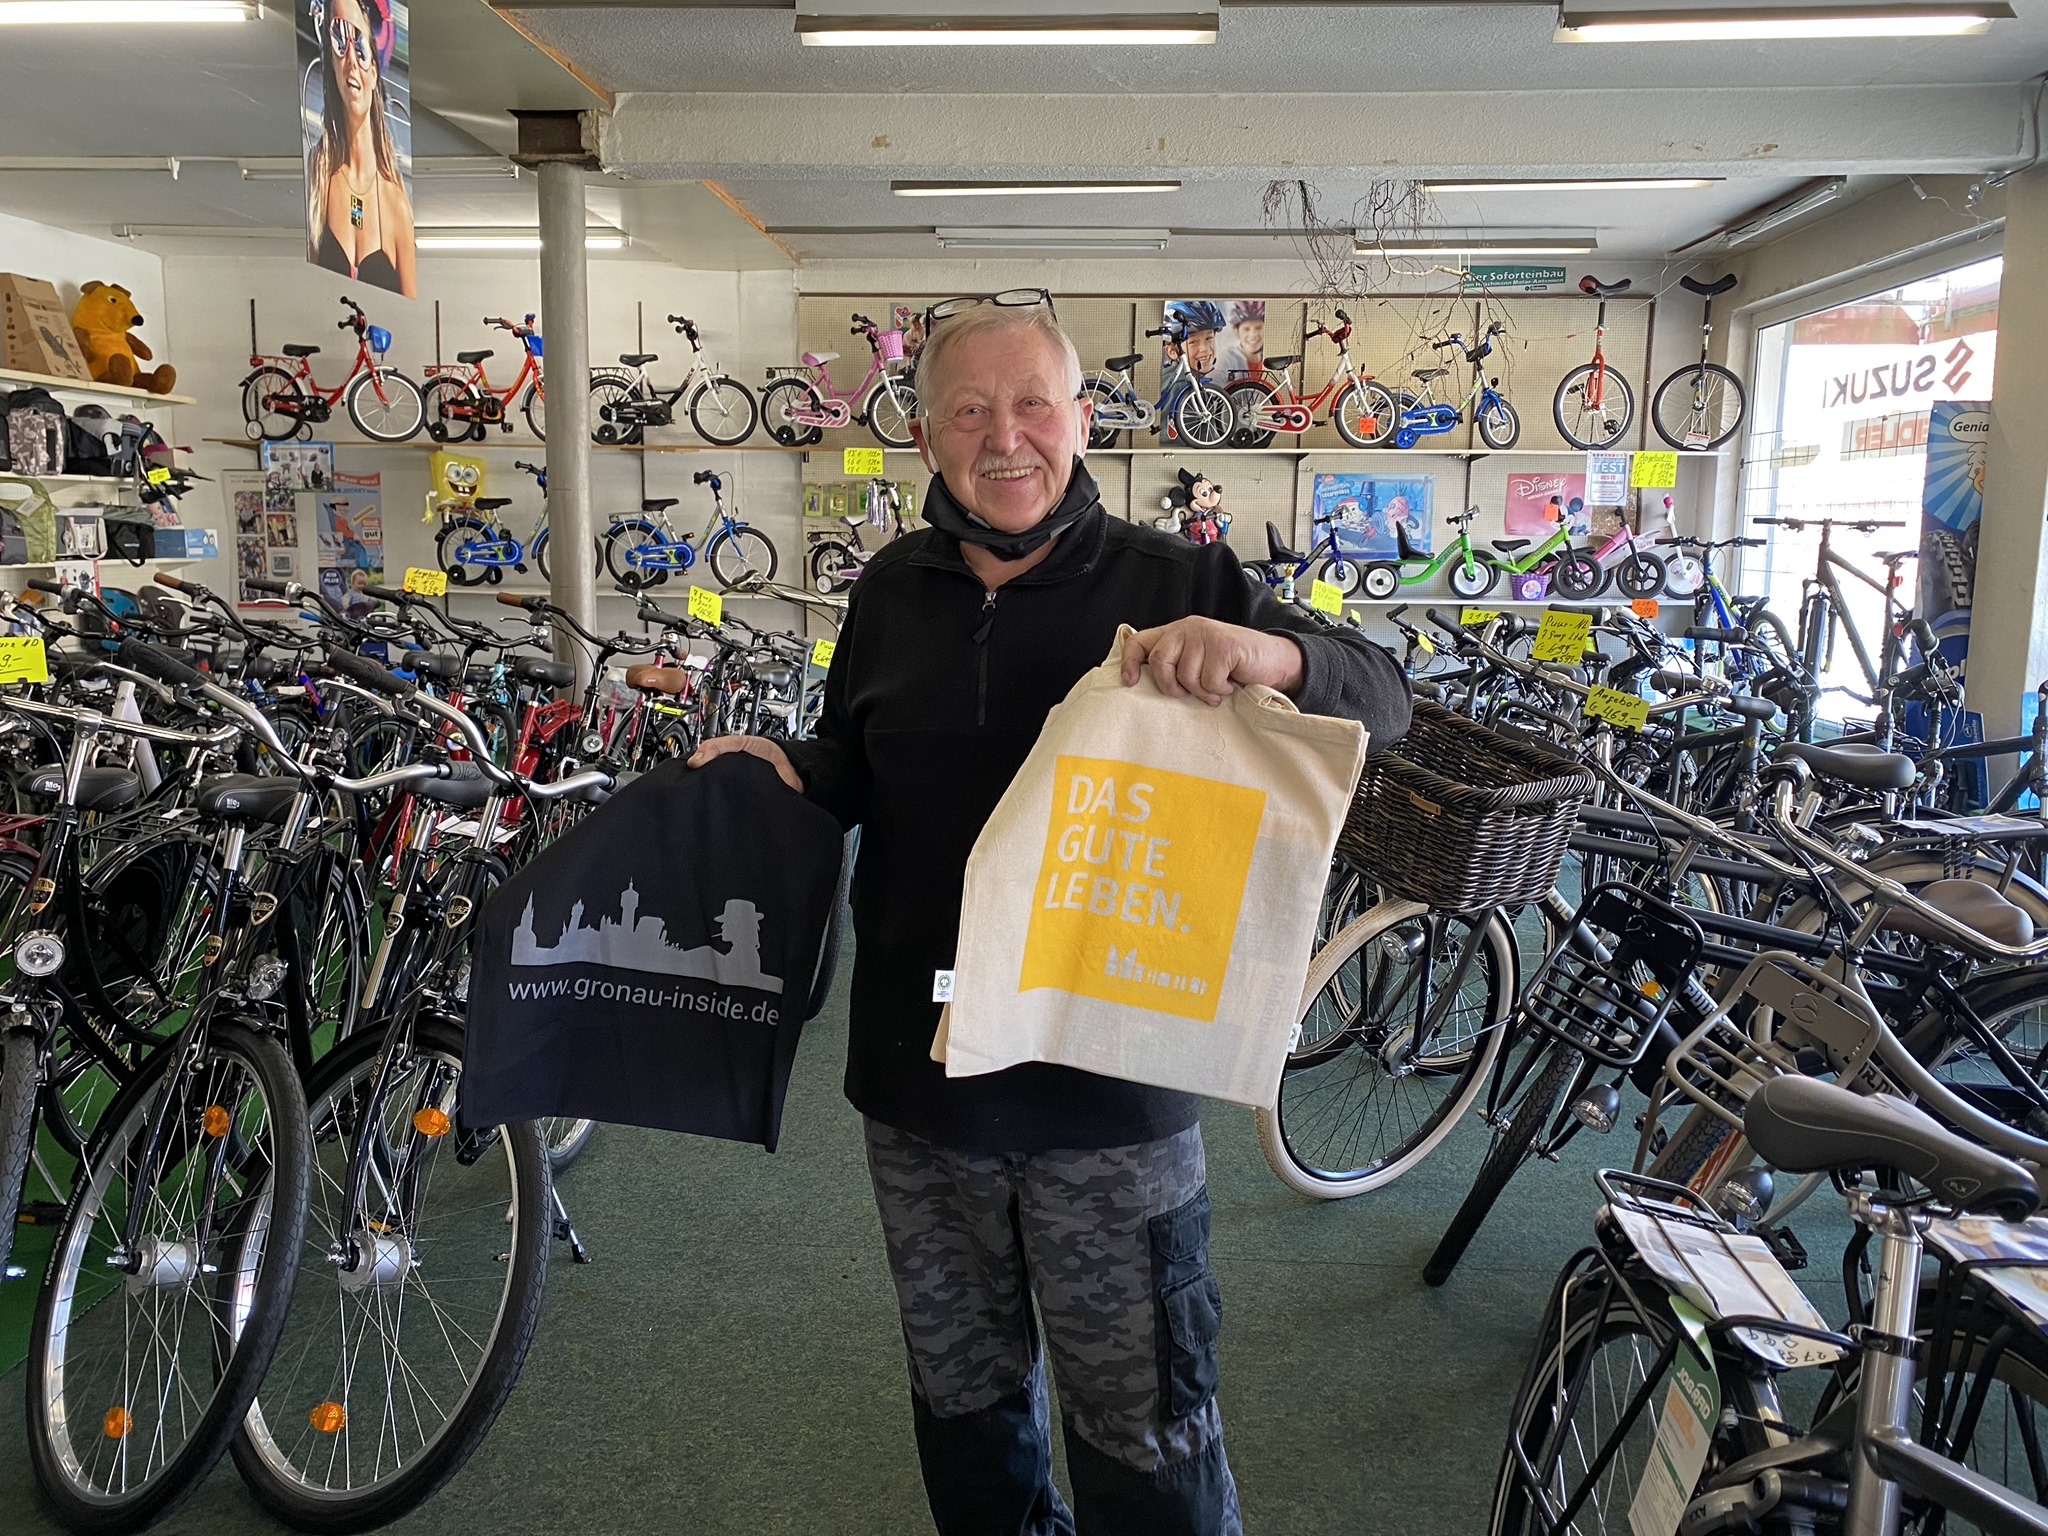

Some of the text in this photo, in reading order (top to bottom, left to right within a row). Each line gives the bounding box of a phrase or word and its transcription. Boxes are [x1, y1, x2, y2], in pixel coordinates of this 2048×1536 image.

[1490, 269, 1564, 281] Soforteinbau
[1593, 462, 1625, 473] TEST
[1588, 701, 1599, 712] €
[1593, 688, 1642, 709] Angebot
[1067, 774, 1155, 823] DAS
[1057, 824, 1171, 878] GUTE
[1042, 871, 1191, 934] LEBEN.
[508, 977, 780, 1027] www.gronau-inside.de
[1676, 1366, 1711, 1421] JOBRAD
